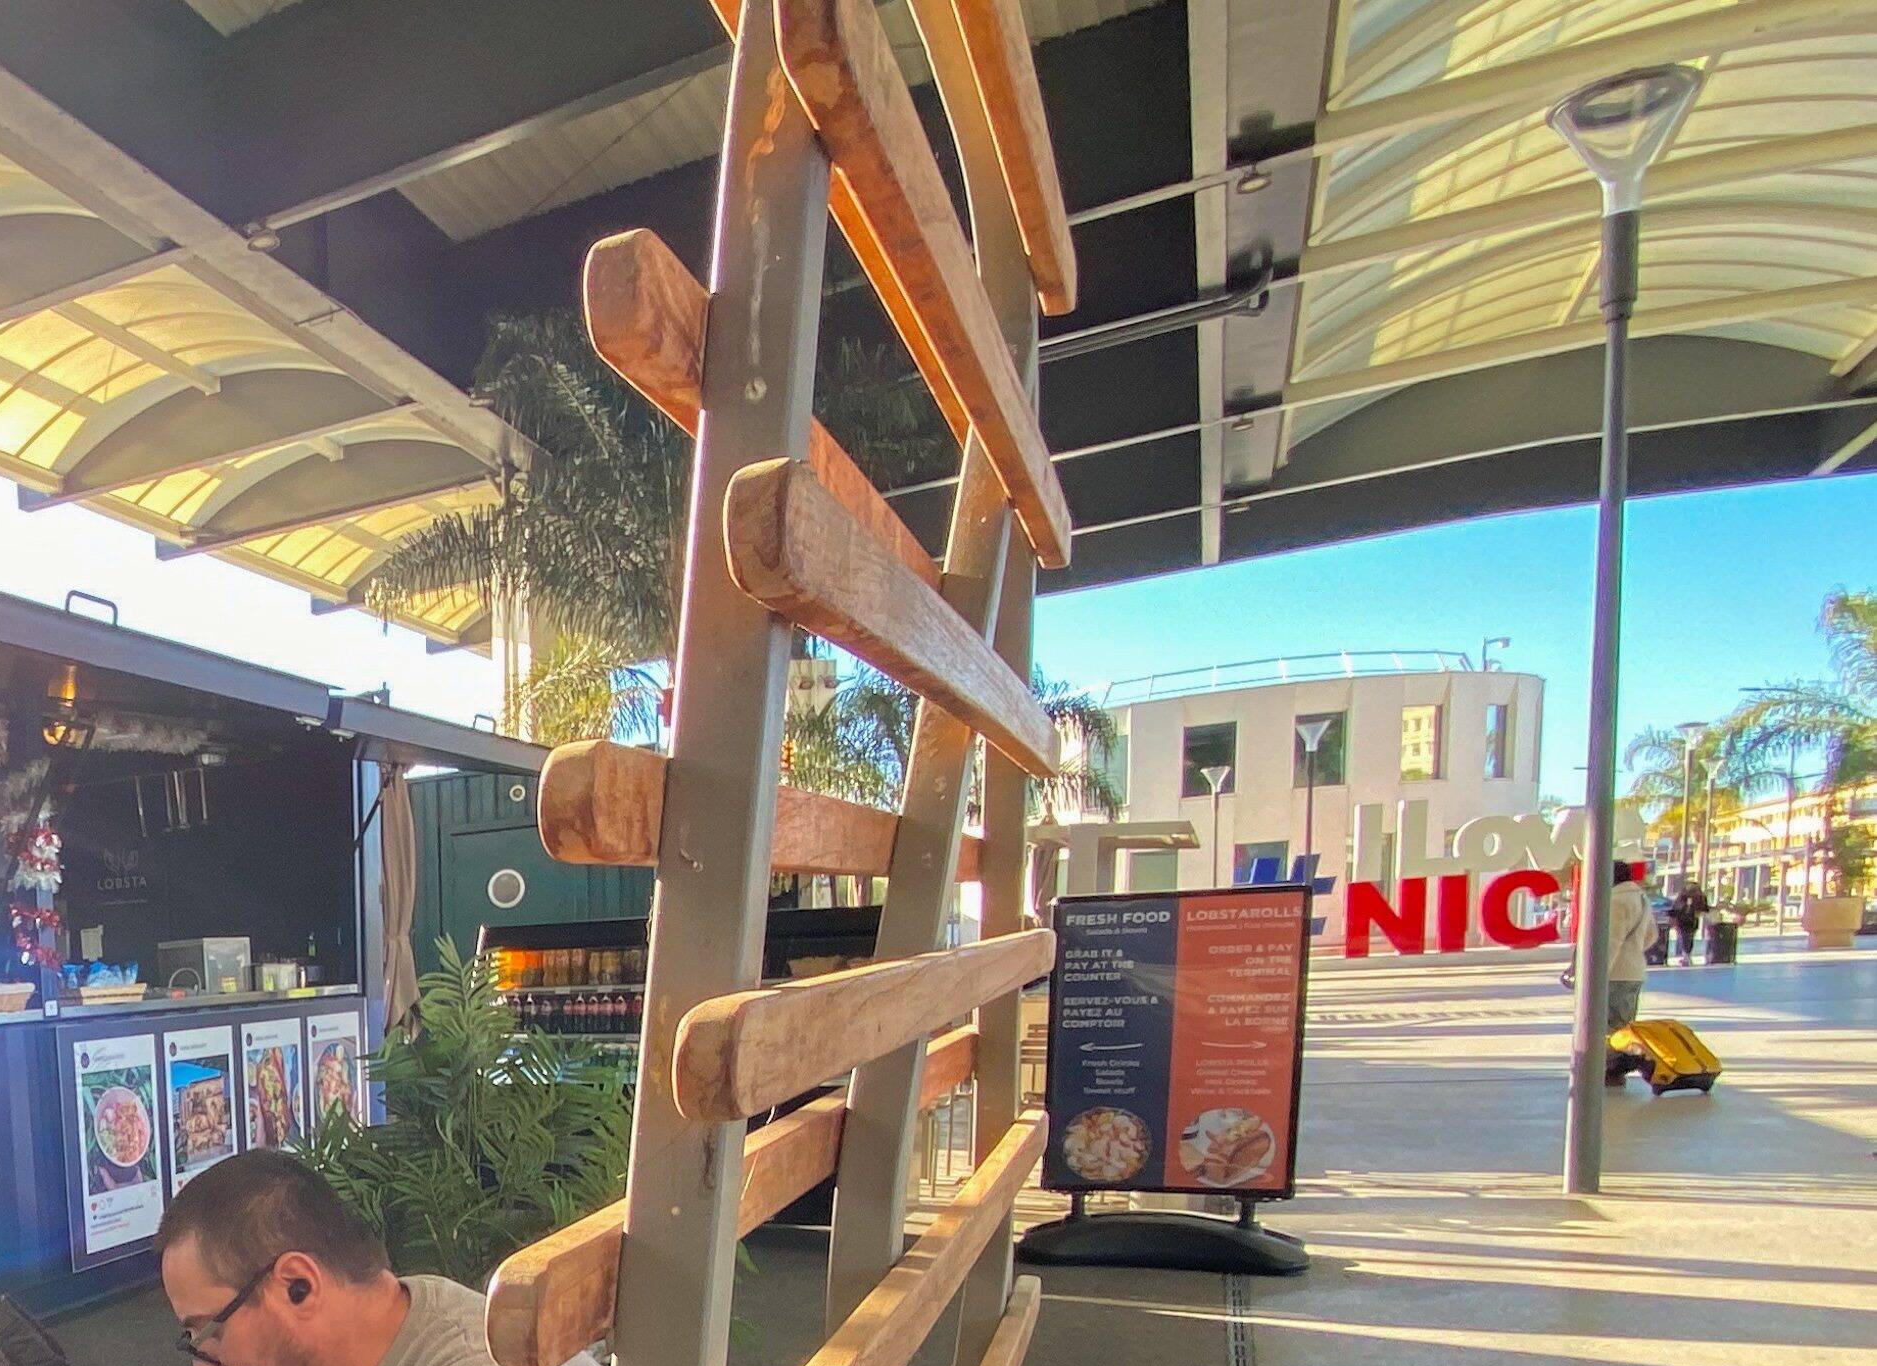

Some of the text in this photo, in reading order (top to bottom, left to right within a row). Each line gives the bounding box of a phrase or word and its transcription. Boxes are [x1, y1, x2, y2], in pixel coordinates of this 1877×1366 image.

[97, 876, 147, 890] LOBSTA
[1186, 906, 1302, 922] LOBSTAROLLS
[1346, 861, 1647, 959] NIC
[1065, 911, 1171, 926] FRESH FOOD
[1064, 949, 1099, 959] GRAB
[1101, 948, 1113, 958] IT
[1208, 944, 1253, 954] ORDER
[1267, 943, 1293, 953] PAY
[1064, 960, 1135, 970] PAY AT THE
[1269, 955, 1292, 965] THE
[1063, 972, 1121, 982] COUNTER
[1227, 968, 1291, 978] TERMINAL
[1206, 992, 1291, 1003] COMMANDEZ
[1062, 1007, 1123, 1018] PAYEZ AU
[1219, 1005, 1260, 1014] PAYEZ
[1062, 1019, 1126, 1028] COMPTOIR
[1225, 1018, 1241, 1026] LA
